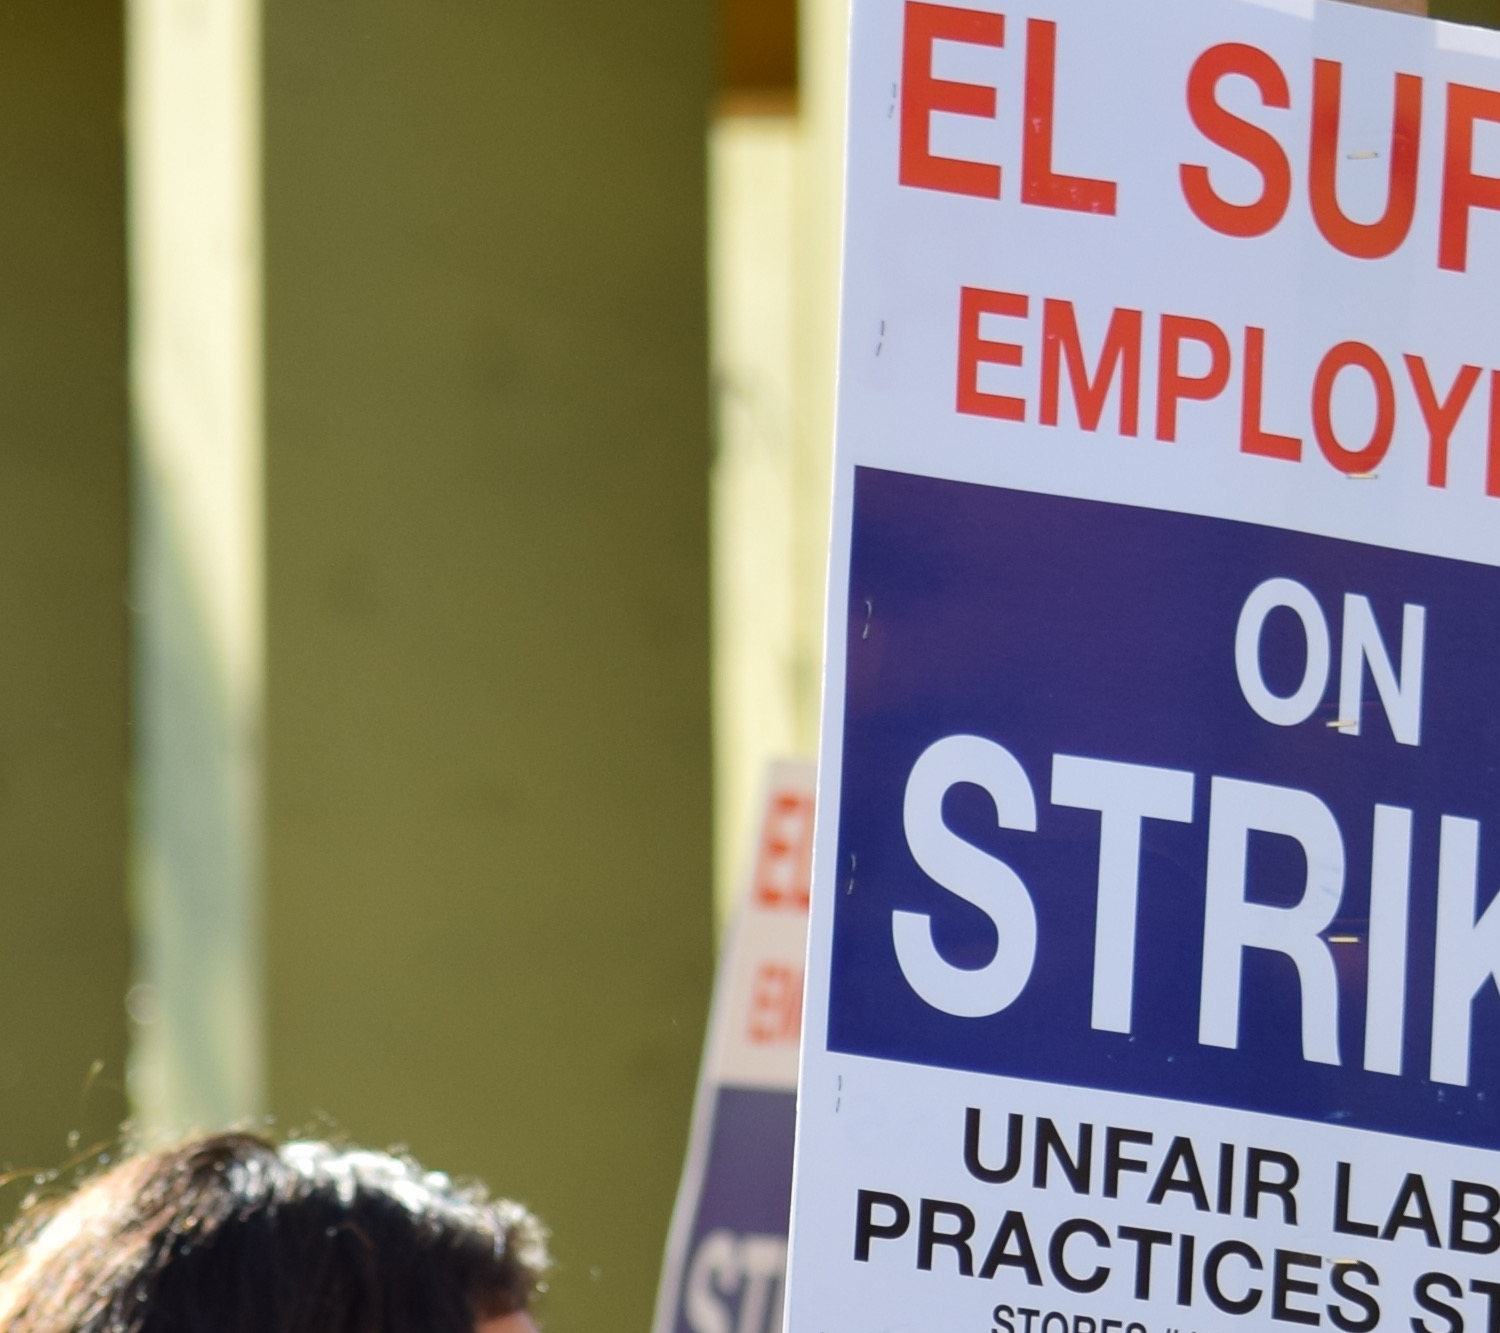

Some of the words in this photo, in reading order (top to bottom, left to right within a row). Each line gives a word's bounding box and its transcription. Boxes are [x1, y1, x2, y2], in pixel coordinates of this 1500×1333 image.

[898, 0, 1118, 217] EL
[1235, 577, 1426, 746] ON
[964, 1107, 1300, 1225] UNFAIR
[854, 1189, 1381, 1333] PRACTICES
